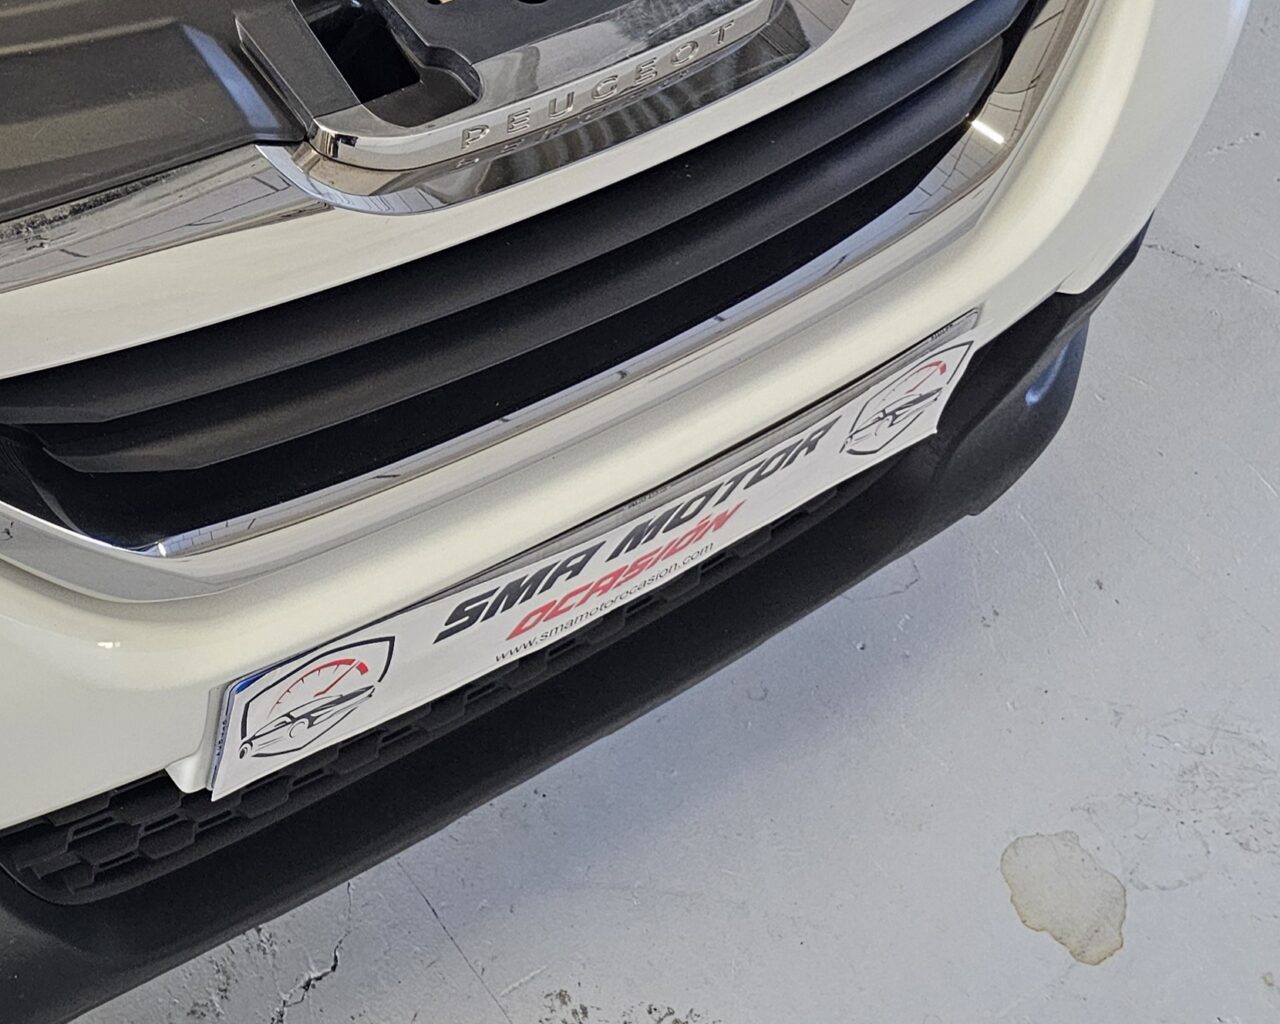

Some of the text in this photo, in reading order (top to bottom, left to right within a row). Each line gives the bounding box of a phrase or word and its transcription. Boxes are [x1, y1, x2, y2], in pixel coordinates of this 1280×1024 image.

[462, 19, 736, 149] PEUGEOT
[433, 415, 841, 644] SMA MOTOR
[494, 542, 714, 662] www.smamotorocasion.com
